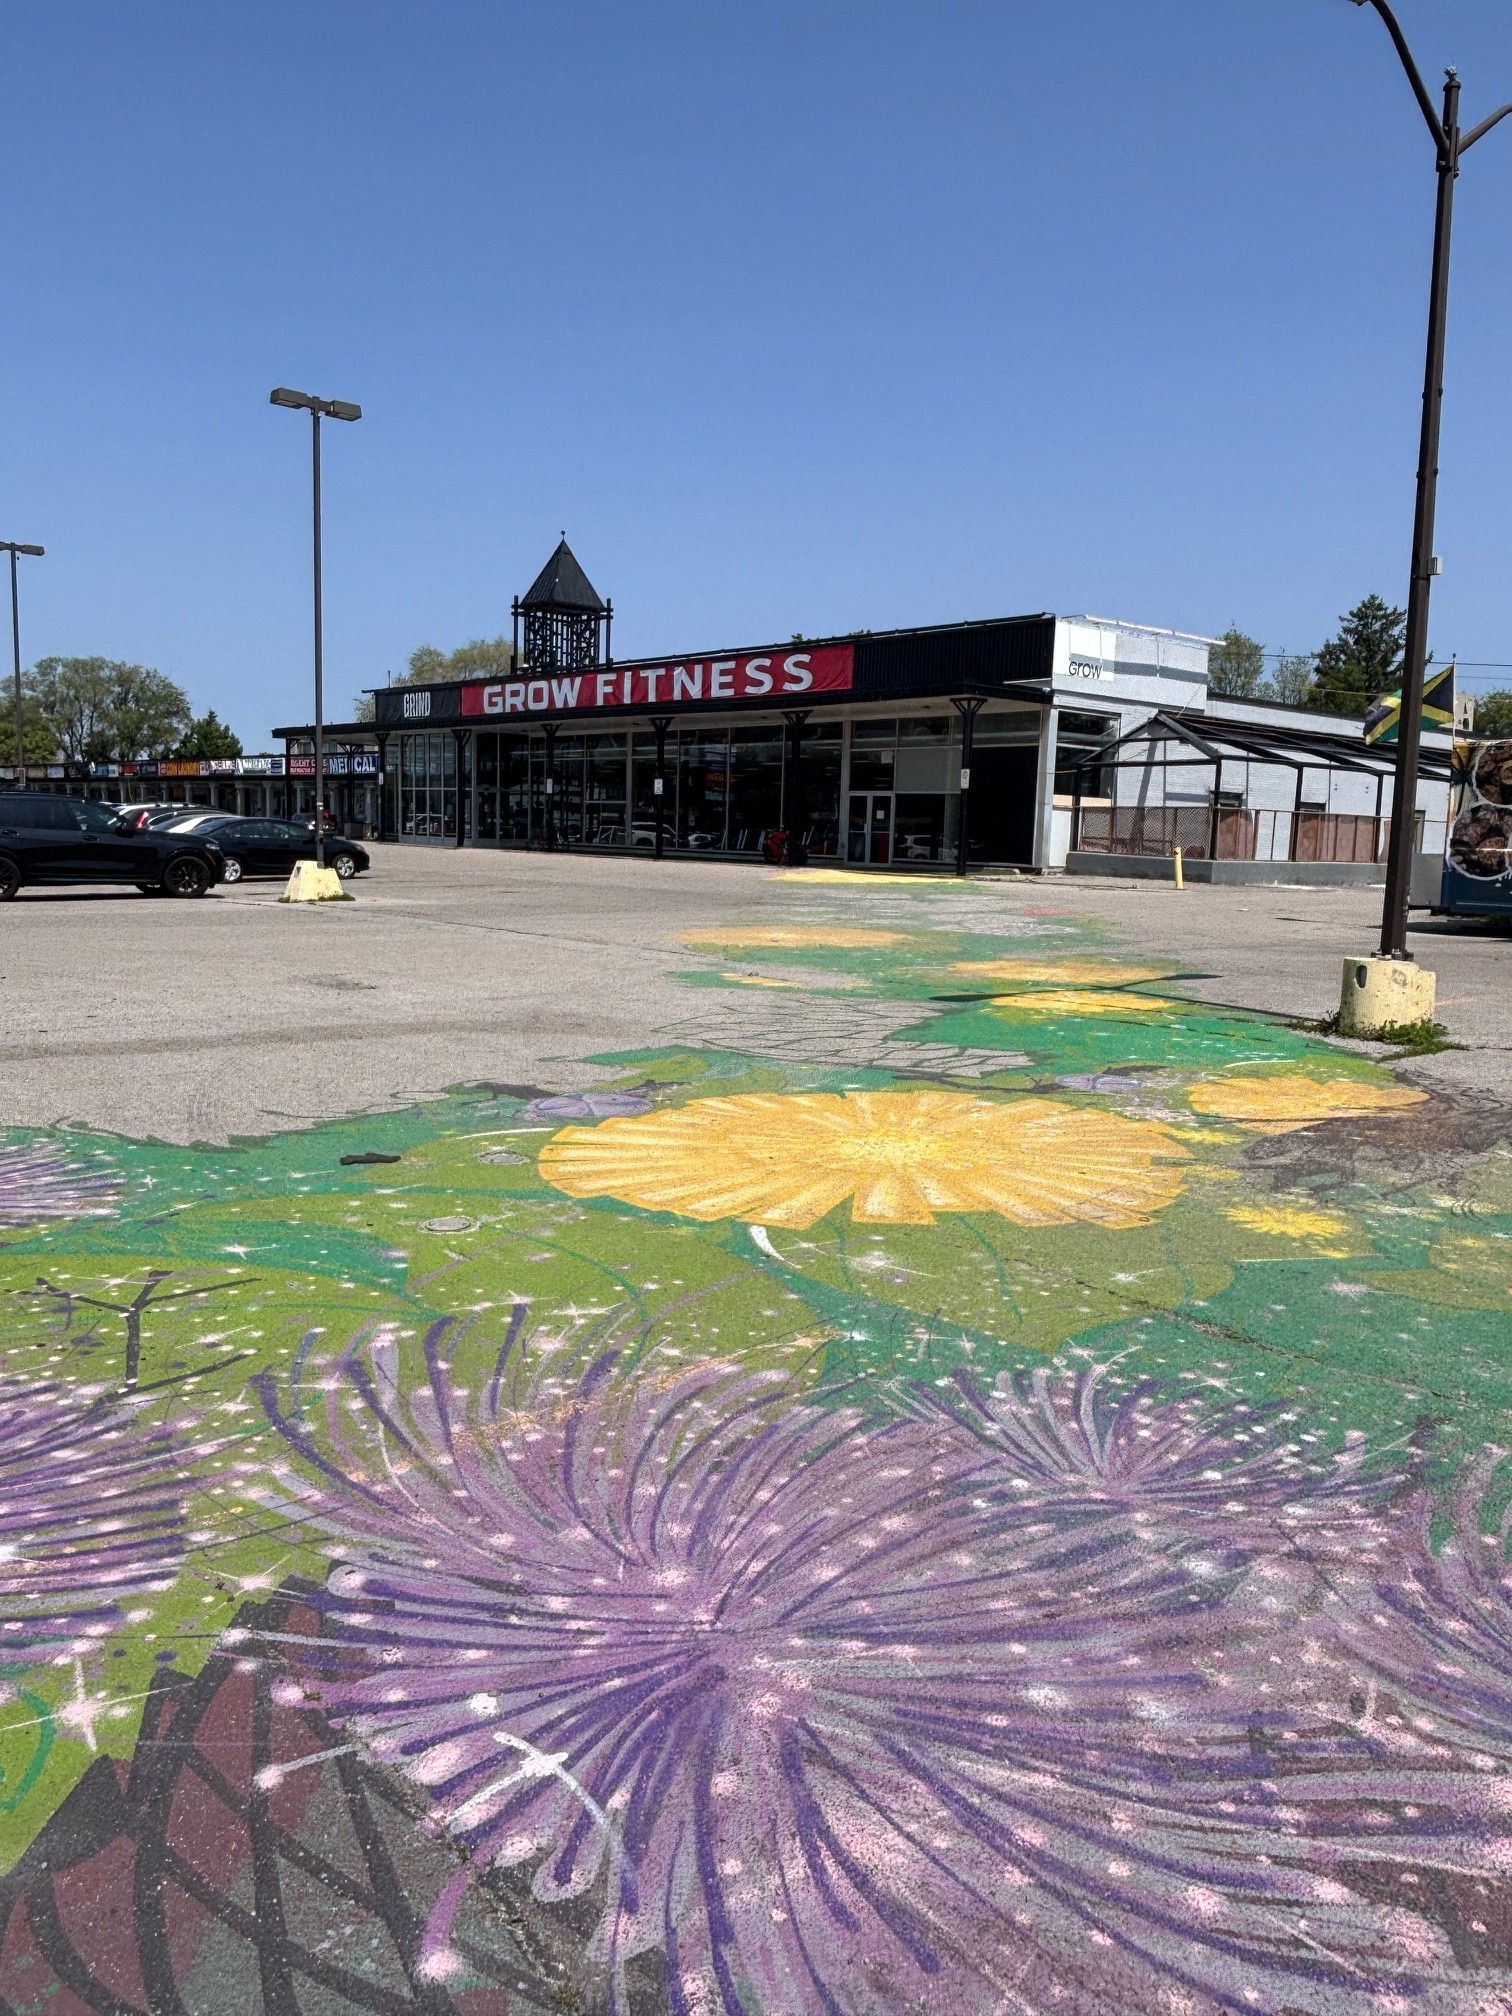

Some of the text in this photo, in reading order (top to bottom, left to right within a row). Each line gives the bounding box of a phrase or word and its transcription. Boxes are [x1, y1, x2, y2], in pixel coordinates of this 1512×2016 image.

[483, 653, 814, 714] GROW FITNESS
[403, 691, 431, 718] GRIND
[329, 756, 376, 774] MECAL
